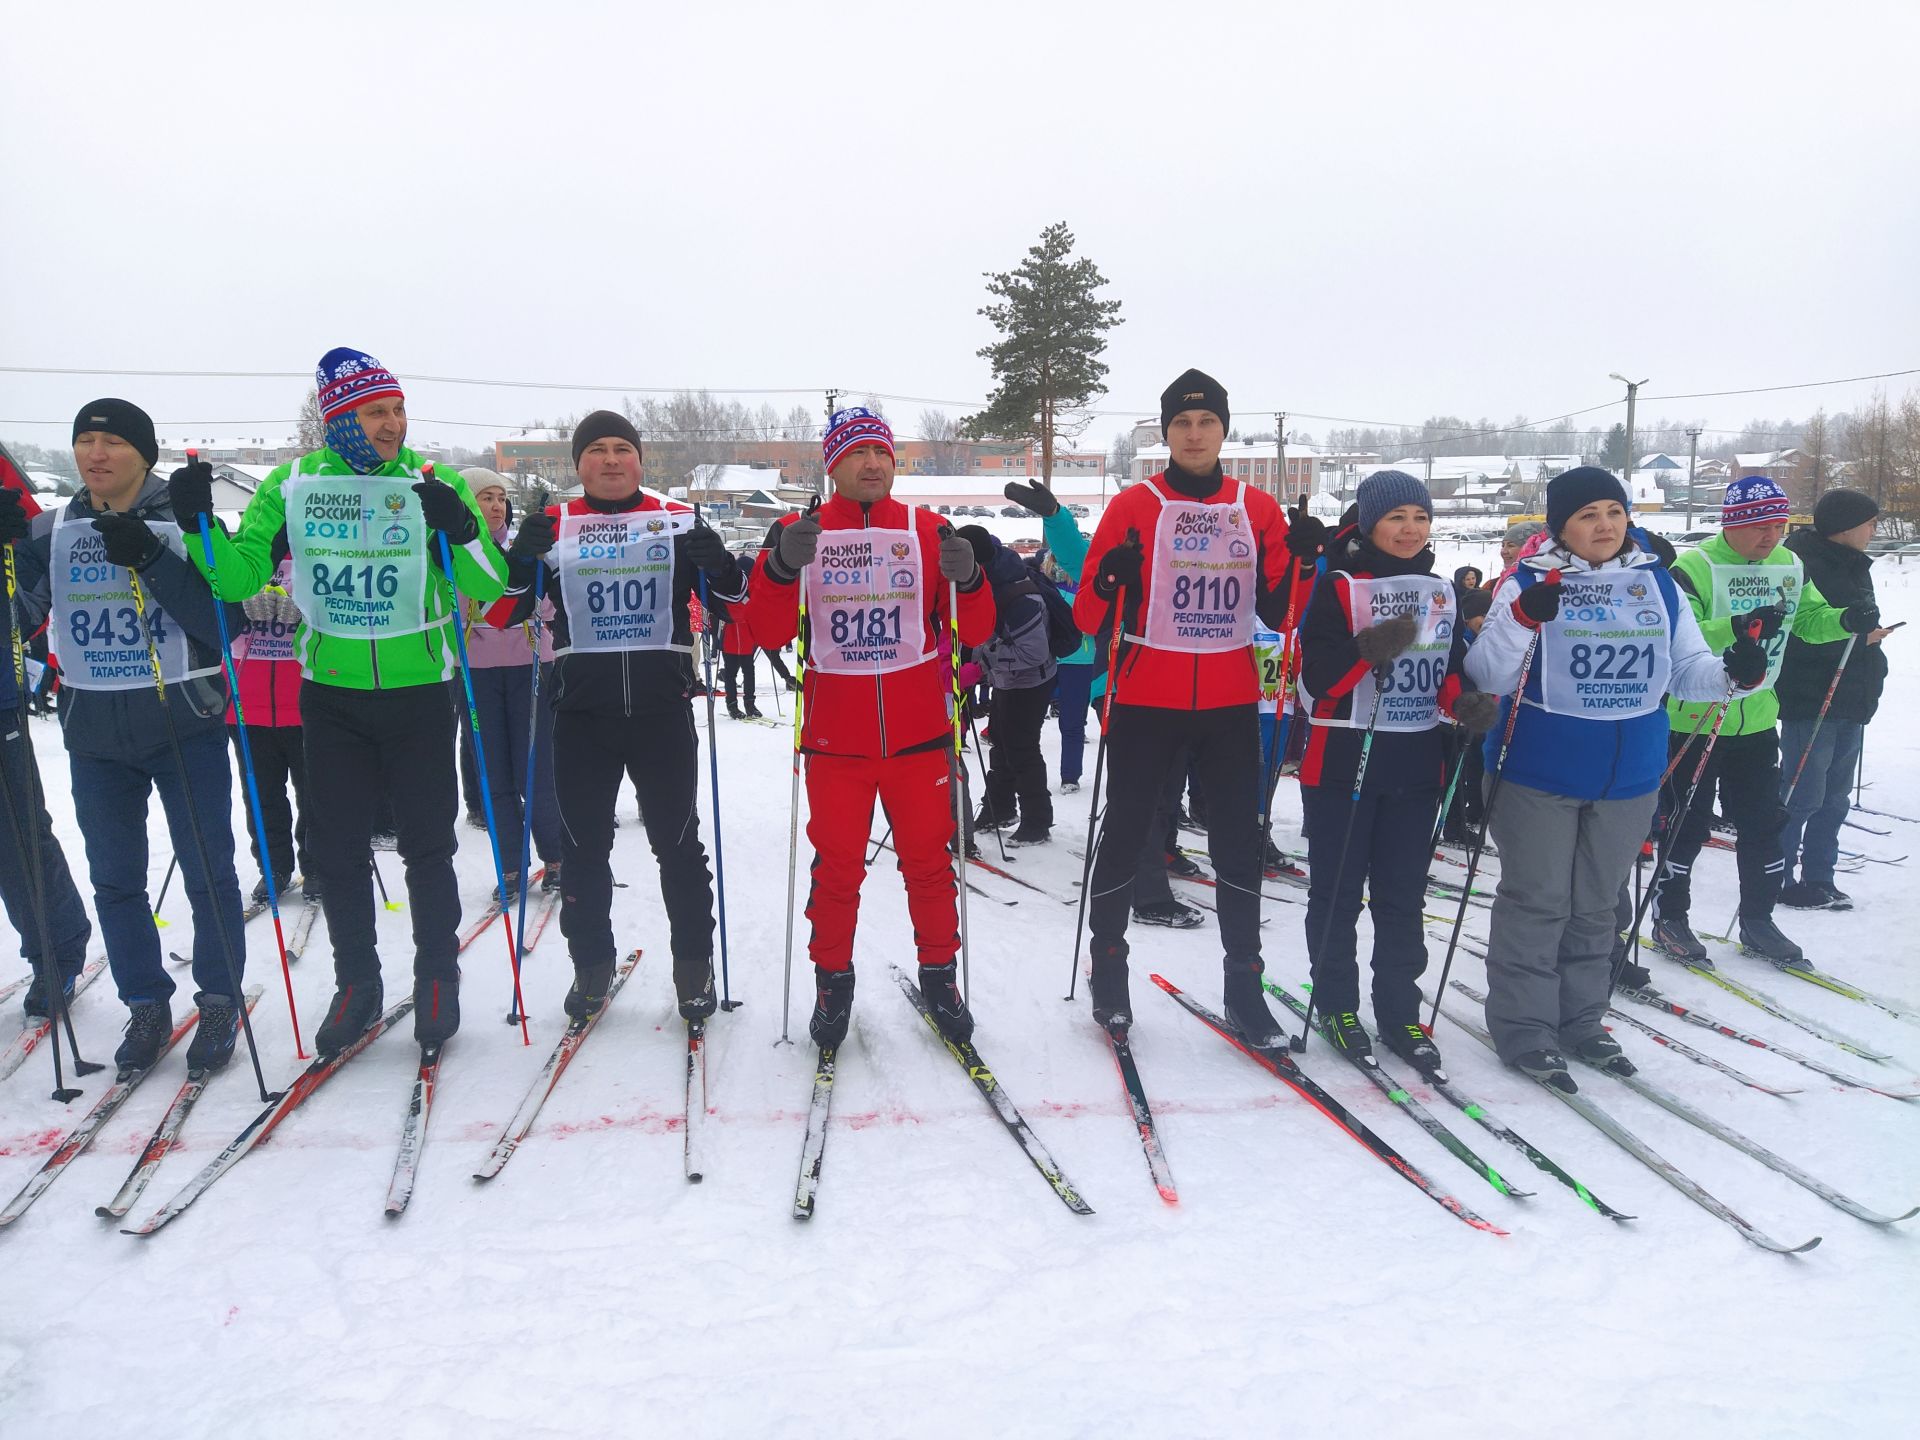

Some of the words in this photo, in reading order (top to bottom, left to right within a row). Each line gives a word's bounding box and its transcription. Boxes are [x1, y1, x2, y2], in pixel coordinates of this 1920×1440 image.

[304, 492, 362, 507] ЛЫЖНЯ
[304, 506, 361, 520] РОССИИ
[304, 521, 358, 539] 2021
[578, 522, 628, 535] ЛЫЖНЯ
[578, 533, 628, 545] РОССИИ
[304, 547, 332, 557] СПОРТ
[578, 545, 625, 560] 2021
[821, 542, 872, 556] ЛЫЖНЯ
[821, 555, 873, 569] РОССИИ
[69, 565, 117, 583] 2021
[312, 563, 399, 599] 8416
[822, 569, 870, 586] 2021
[1728, 577, 1770, 588] ЛЫЖНЯ
[586, 577, 657, 614] 8101
[1172, 575, 1241, 611] 8110
[1370, 590, 1420, 605] ЛЫЖНЯ
[1729, 587, 1770, 598] РОССИИ
[324, 597, 395, 613] РЕСПУБЛИКА
[1562, 594, 1613, 607] РОССИИ
[1371, 603, 1420, 617] РОССИИ
[1564, 607, 1617, 622] 2021
[328, 612, 390, 627] ТАТАРСТАН
[591, 613, 655, 628] РЕСПУБЛИКА
[830, 605, 901, 644] 8181
[1173, 612, 1237, 624] РЕСПУБЛИКА
[70, 607, 168, 647] 8434
[595, 627, 651, 641] ТАТАРСТАН
[1177, 626, 1233, 638] ТАТАРСТАН
[841, 648, 898, 662] ТАТАРСТАН
[1569, 643, 1655, 680] 8221
[1576, 682, 1649, 695] РЕСПУБЛИКА
[1581, 697, 1642, 709] ТАТАРСТАН
